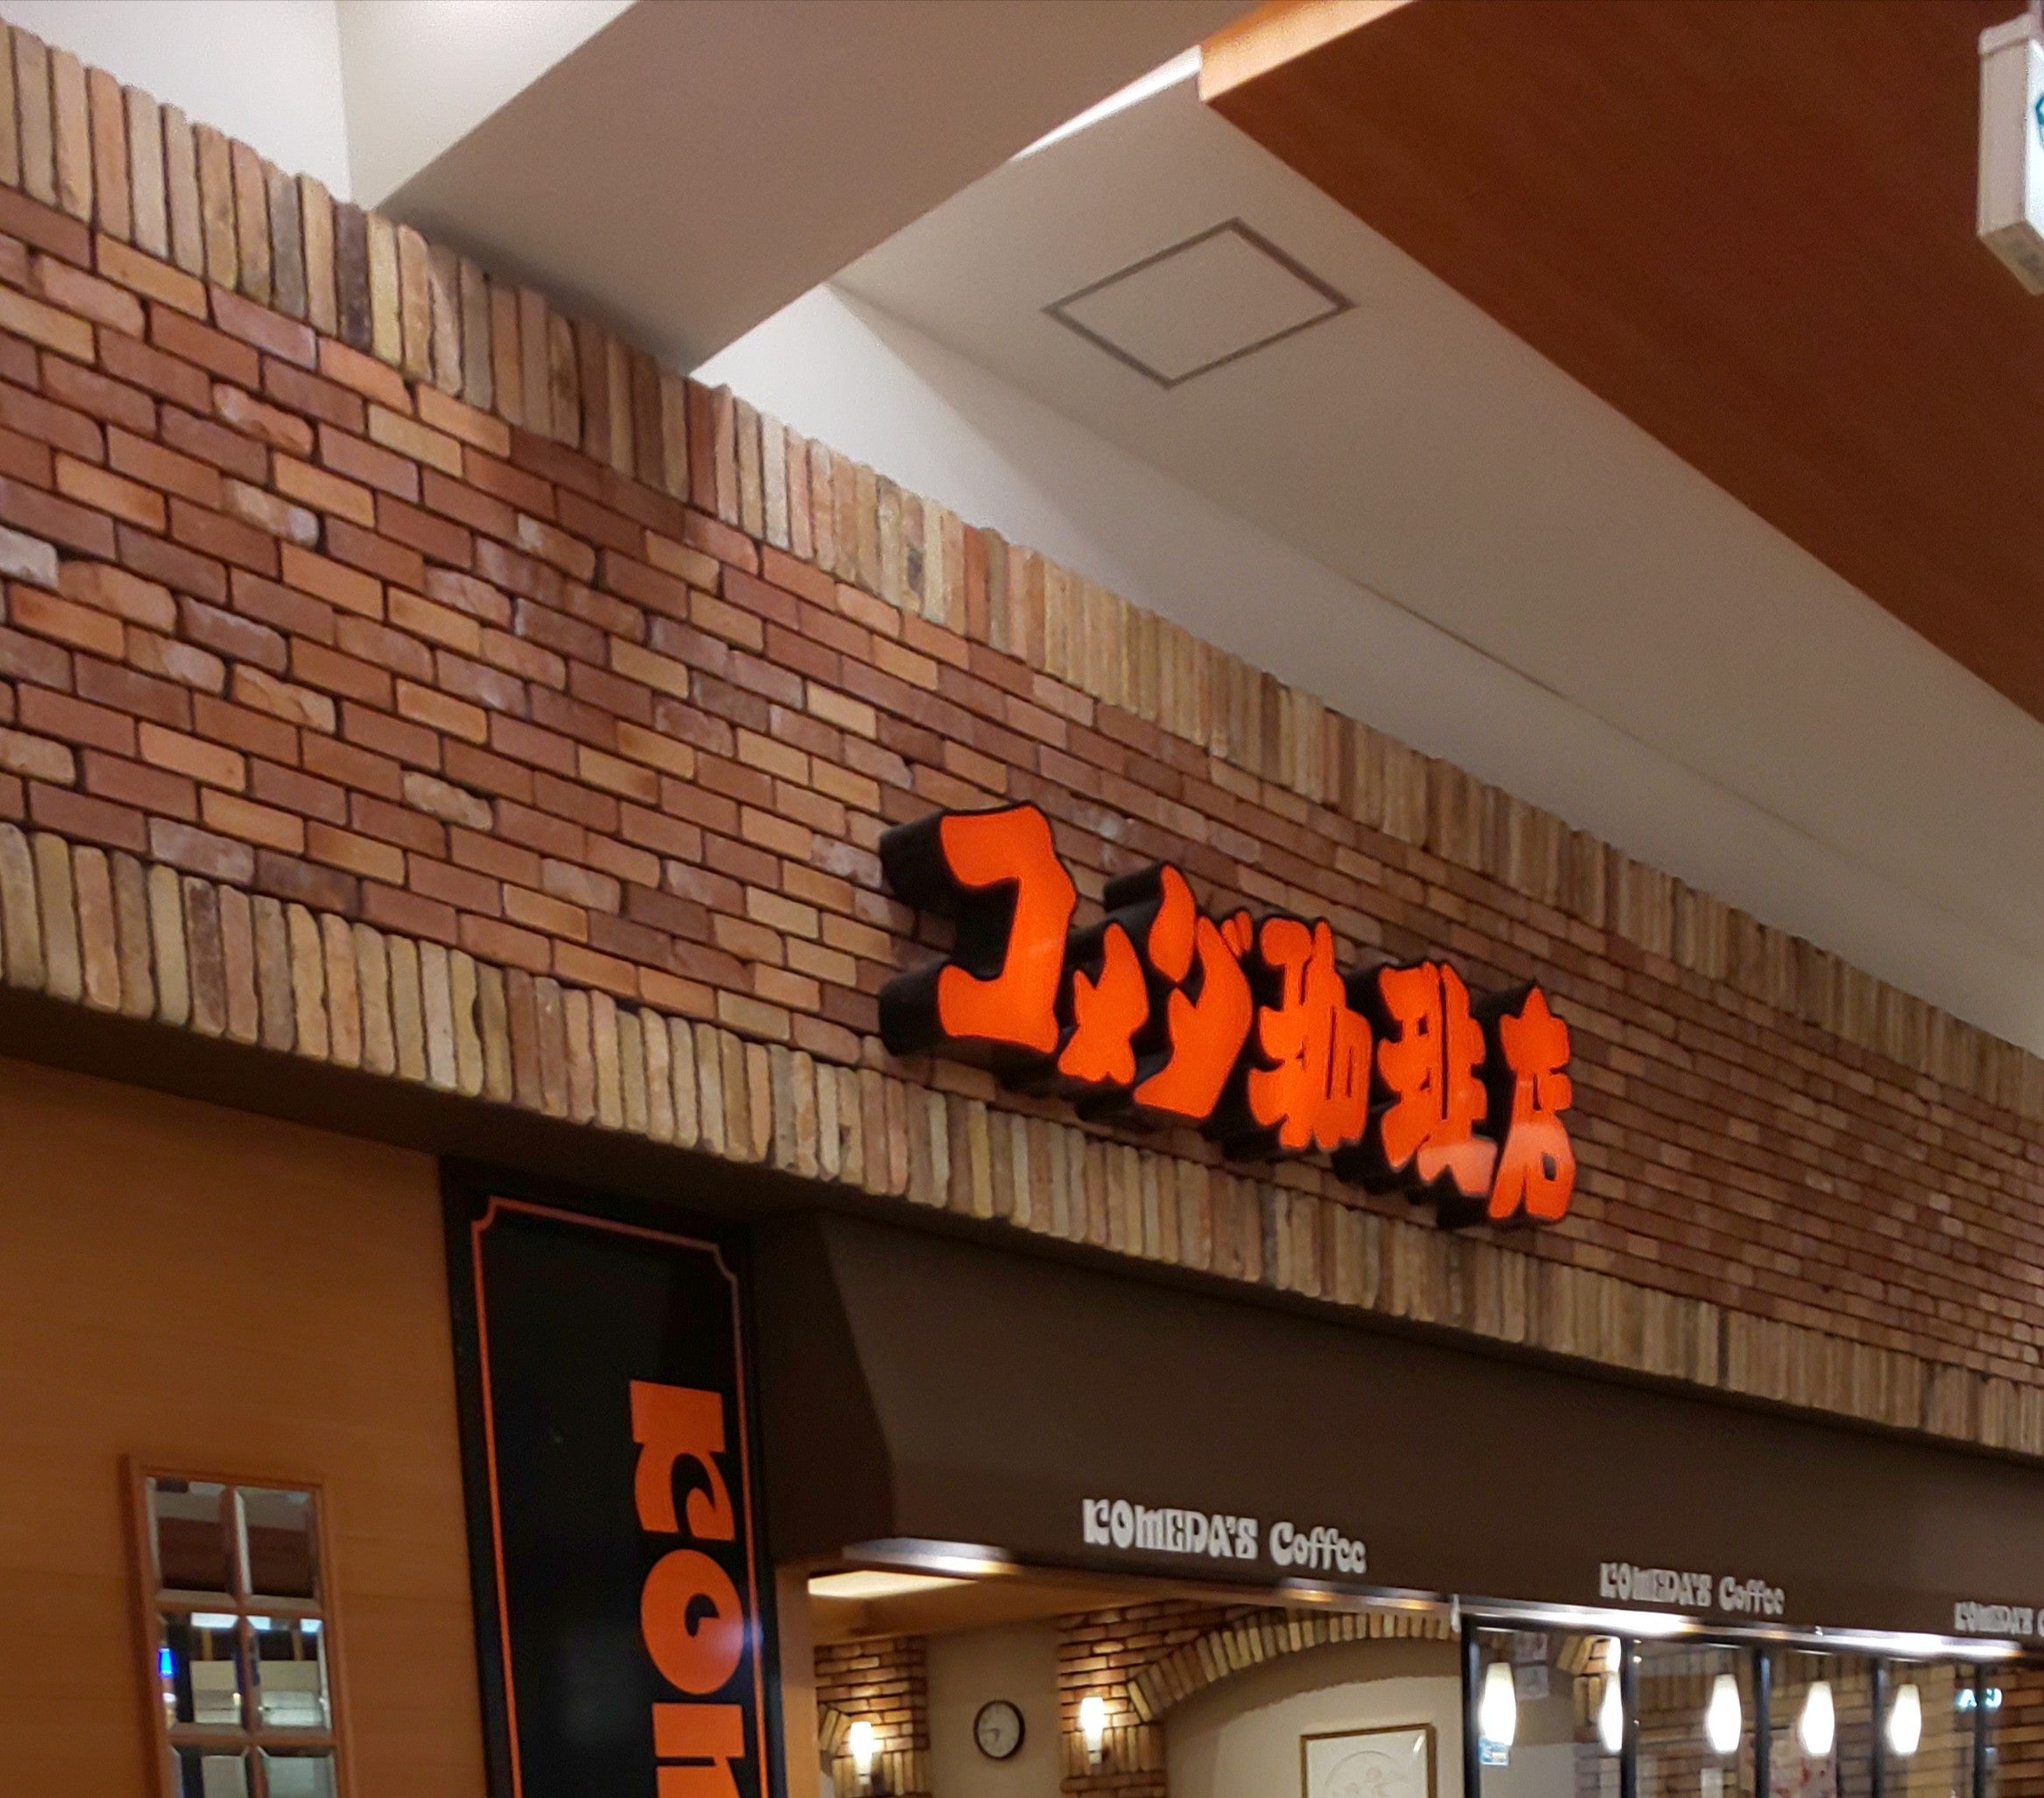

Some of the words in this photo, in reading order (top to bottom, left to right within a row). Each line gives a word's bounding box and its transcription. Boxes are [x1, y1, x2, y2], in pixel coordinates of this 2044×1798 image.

[934, 799, 1575, 1223] コメダ珈琲店
[1081, 1497, 1258, 1560] KOMEDA'S
[1270, 1521, 1367, 1574] Coffee
[1718, 1575, 1785, 1615] Coffee
